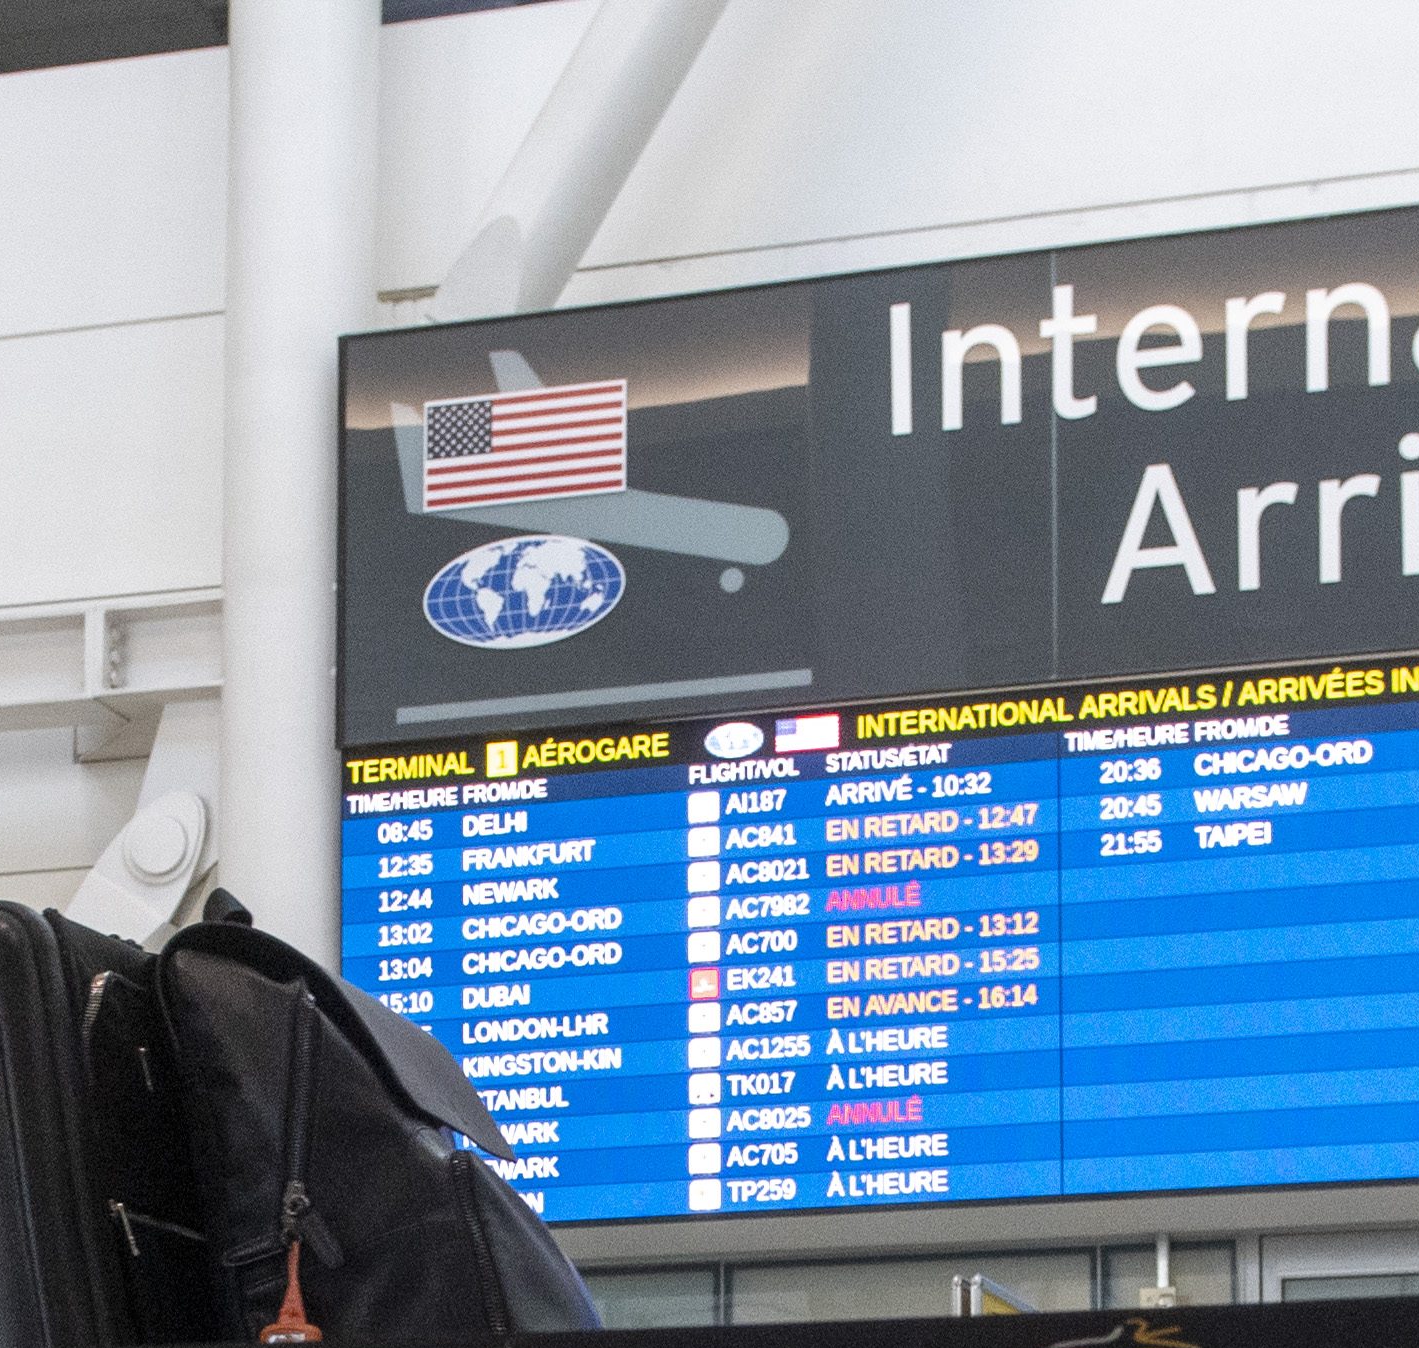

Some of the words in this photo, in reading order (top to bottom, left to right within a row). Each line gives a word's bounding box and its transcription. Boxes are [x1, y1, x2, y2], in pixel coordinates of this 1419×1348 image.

[857, 698, 1074, 739] INTERNATIONAL
[1079, 684, 1217, 719] ARRIVALS
[1222, 681, 1233, 707] /
[1238, 668, 1385, 706] ARRIVÉES
[347, 752, 475, 784] TERMINAL
[522, 733, 669, 768] AÉROGARE
[1064, 722, 1189, 751] TIME/HEURE
[1100, 758, 1161, 783] 20:36
[1194, 740, 1373, 776] CHICAGO-ORD
[347, 786, 458, 813] TIME/HEURE
[689, 757, 800, 784] FLIGHT/VOL
[378, 819, 432, 843] 08:45
[463, 811, 527, 836] DELHI
[726, 789, 786, 814] AI187
[826, 774, 912, 806] ARRIVÉ
[932, 772, 991, 797] 10:32
[1100, 794, 1162, 820] 20:45
[1194, 782, 1308, 812] WARSAW
[379, 853, 433, 878] 12:35
[463, 839, 595, 871] FRANKFURT
[726, 824, 796, 849] AC841
[826, 819, 859, 841] EN
[864, 810, 959, 838] RETARD
[979, 803, 1038, 829] 12:47
[1101, 830, 1162, 856] 21:55
[1195, 821, 1271, 848] TAIPEI
[379, 888, 432, 912] 12:44
[463, 878, 558, 905] NEWARK
[726, 858, 809, 884] AC8021
[826, 854, 859, 877] EN
[864, 846, 959, 873] RETARD
[979, 840, 1038, 865] 13:29
[379, 922, 432, 946] 13:02
[462, 907, 622, 939] CHICAGO-ORD
[726, 893, 809, 920] AC7982
[826, 881, 920, 911] ANNULÉ
[379, 957, 432, 980] 13:04
[463, 942, 622, 974] CHICAGO-ORD
[726, 930, 797, 954] AC700
[827, 926, 859, 948] EN
[865, 917, 960, 944] RETARD
[980, 912, 1038, 937] 13:12
[463, 984, 530, 1009] DUBAI
[727, 966, 795, 990] EK241
[827, 961, 860, 983] EN
[865, 953, 960, 980] RETARD
[980, 947, 1040, 973] 15:25
[463, 1013, 608, 1043] LONDON-LHR
[726, 1000, 797, 1025] AC857
[827, 997, 860, 1019] EN
[865, 989, 958, 1016] AVANCE
[979, 984, 1038, 1009] 16:14
[463, 1048, 621, 1077] KINGSTON-KIN
[726, 1035, 811, 1060] AC1255
[826, 1029, 844, 1054] À
[849, 1026, 948, 1053] L'HEURE
[477, 1086, 570, 1112] TANBUL
[727, 1071, 795, 1095] TK017
[827, 1065, 844, 1089] À
[849, 1062, 948, 1088] L'HEURE
[727, 1106, 811, 1131] AC8025
[484, 1156, 560, 1181] WARK
[727, 1142, 798, 1167] AC705
[827, 1136, 845, 1161] À
[849, 1134, 948, 1160] L'HEURE
[727, 1178, 796, 1202] TP259
[827, 1171, 845, 1197] À
[849, 1169, 948, 1196] L'HEURE
